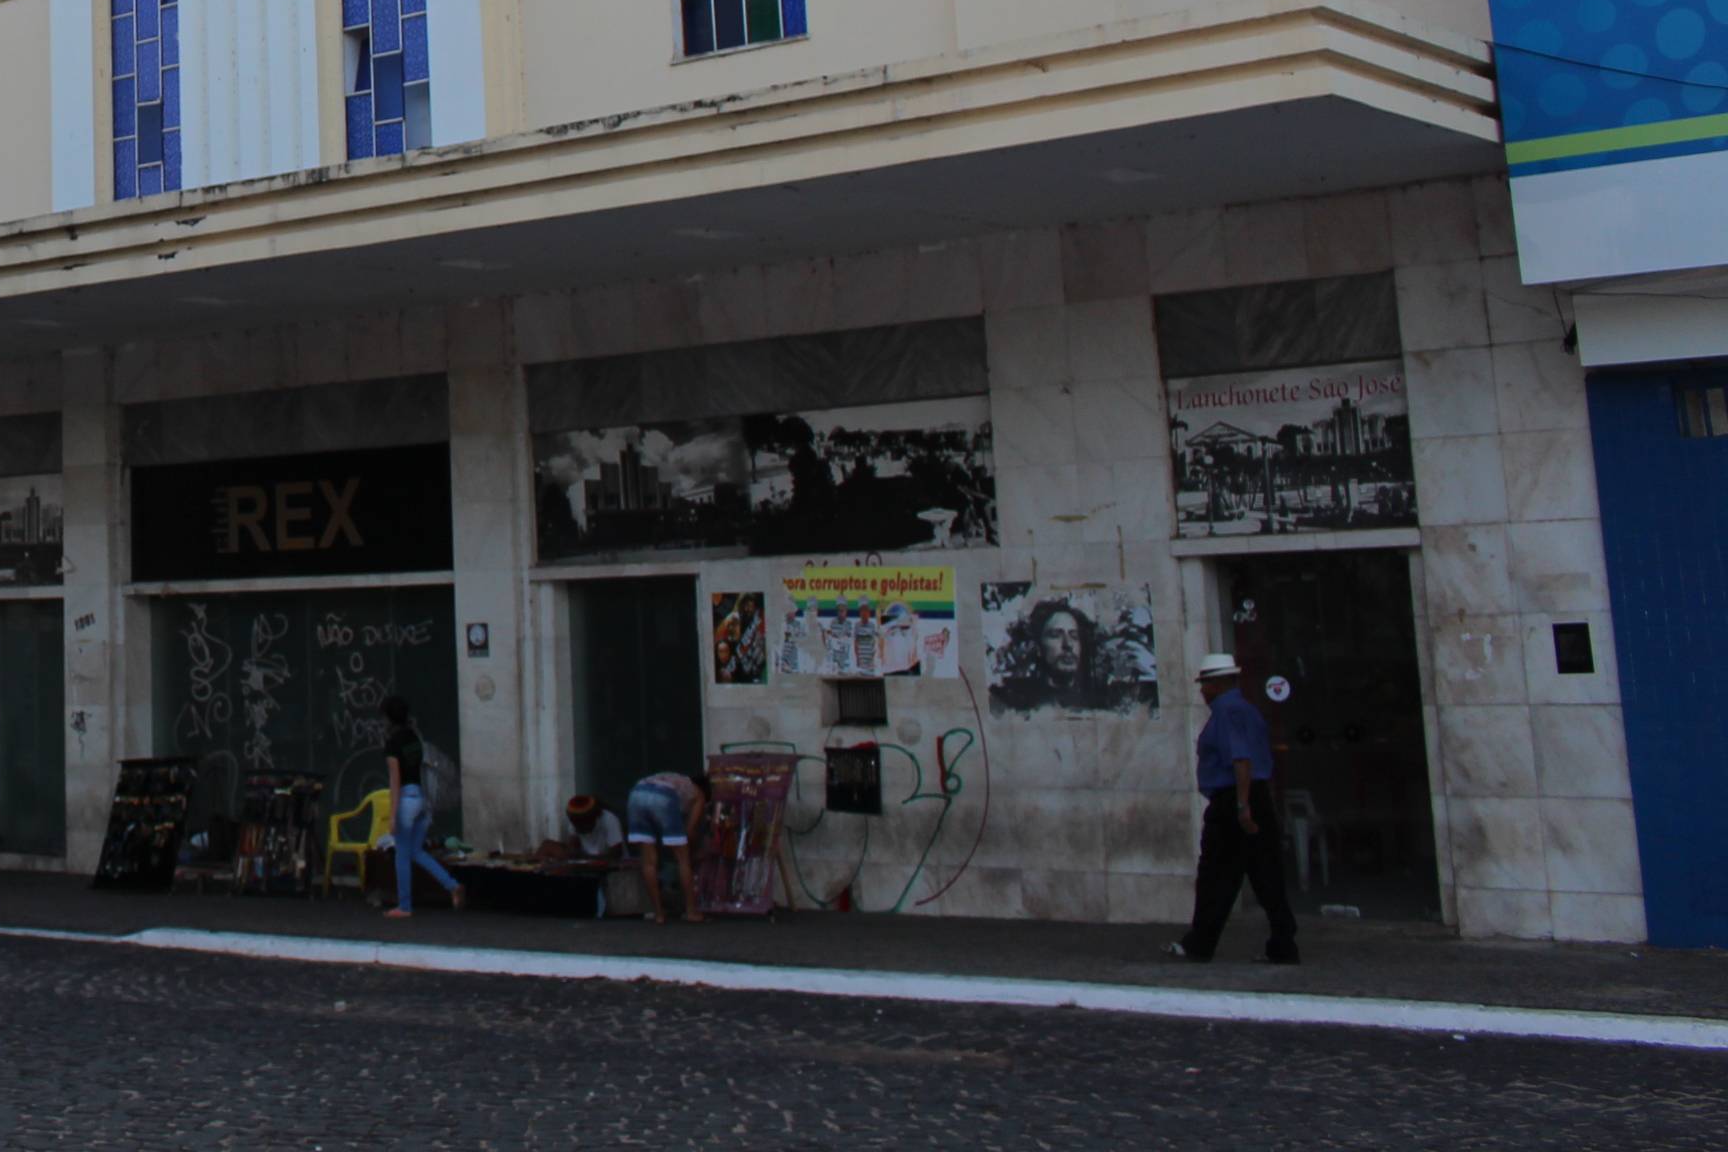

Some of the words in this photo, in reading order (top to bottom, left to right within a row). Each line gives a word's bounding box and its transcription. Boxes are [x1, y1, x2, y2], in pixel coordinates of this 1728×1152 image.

[1177, 382, 1301, 410] Lanchonete
[224, 476, 366, 553] REX
[808, 576, 867, 595] corruptos
[870, 577, 878, 591] e
[880, 571, 944, 596] golpistas!
[316, 612, 354, 648] NÃO
[349, 651, 364, 673] O
